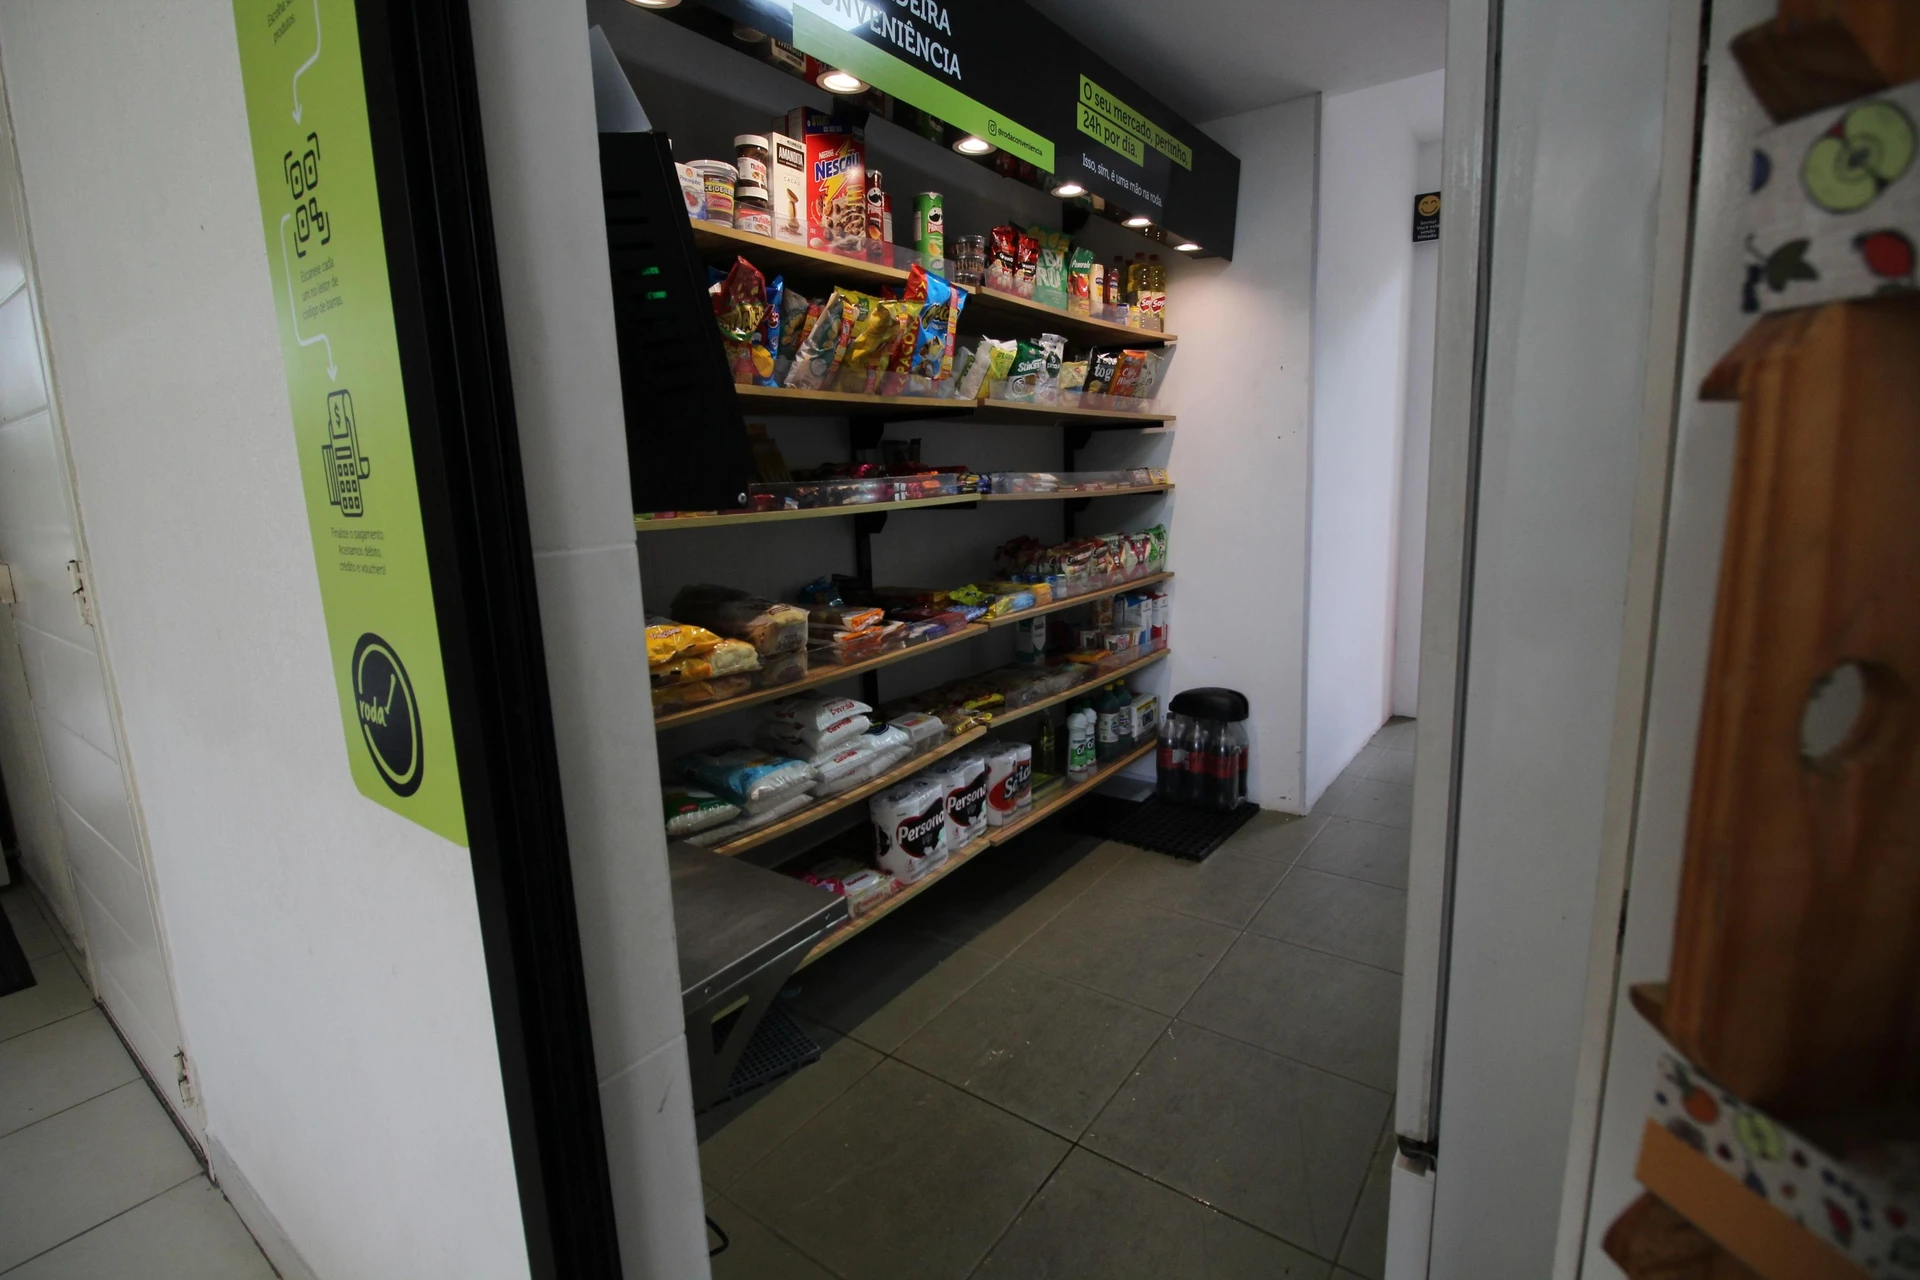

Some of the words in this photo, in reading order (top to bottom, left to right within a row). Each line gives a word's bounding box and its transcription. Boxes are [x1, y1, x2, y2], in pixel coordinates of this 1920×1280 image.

[1083, 82, 1093, 101] O
[1094, 93, 1111, 115] seu
[1113, 104, 1153, 143] mercado,
[1154, 131, 1189, 167] pertinho,
[1083, 110, 1102, 137] 24h
[1104, 126, 1121, 145] por
[1122, 136, 1138, 158] dia.
[783, 176, 800, 187] CACAU
[814, 151, 861, 183] NESCAU
[1082, 153, 1097, 173] Isso,
[1097, 163, 1110, 180] sim,
[1110, 172, 1116, 182] é
[1116, 175, 1129, 190] uma
[1130, 180, 1143, 197] mão
[1142, 189, 1150, 201] na
[1150, 191, 1163, 208] roda.
[359, 696, 387, 728] roda
